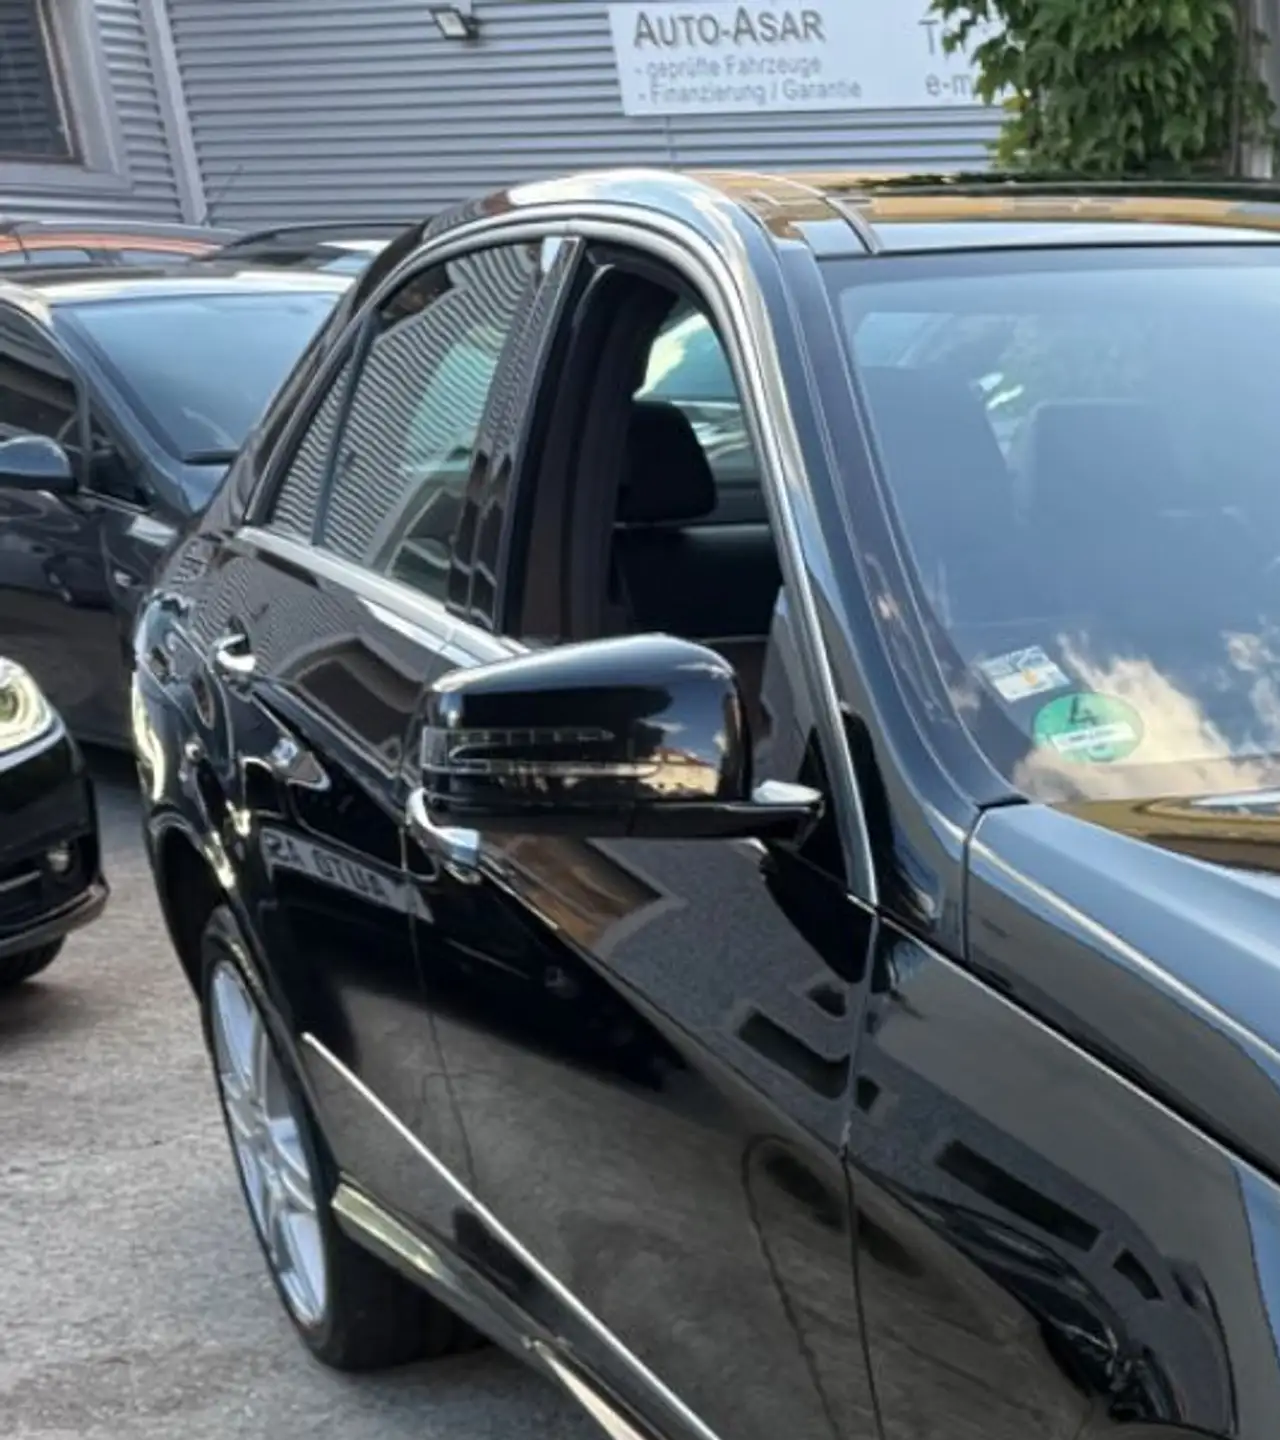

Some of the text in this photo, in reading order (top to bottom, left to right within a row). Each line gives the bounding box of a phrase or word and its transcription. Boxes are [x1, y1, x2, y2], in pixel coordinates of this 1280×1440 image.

[647, 55, 721, 79] geprüfte
[724, 54, 823, 79] Fahrzeuge
[651, 84, 767, 106] Finanzierung
[781, 77, 862, 102] Garantie
